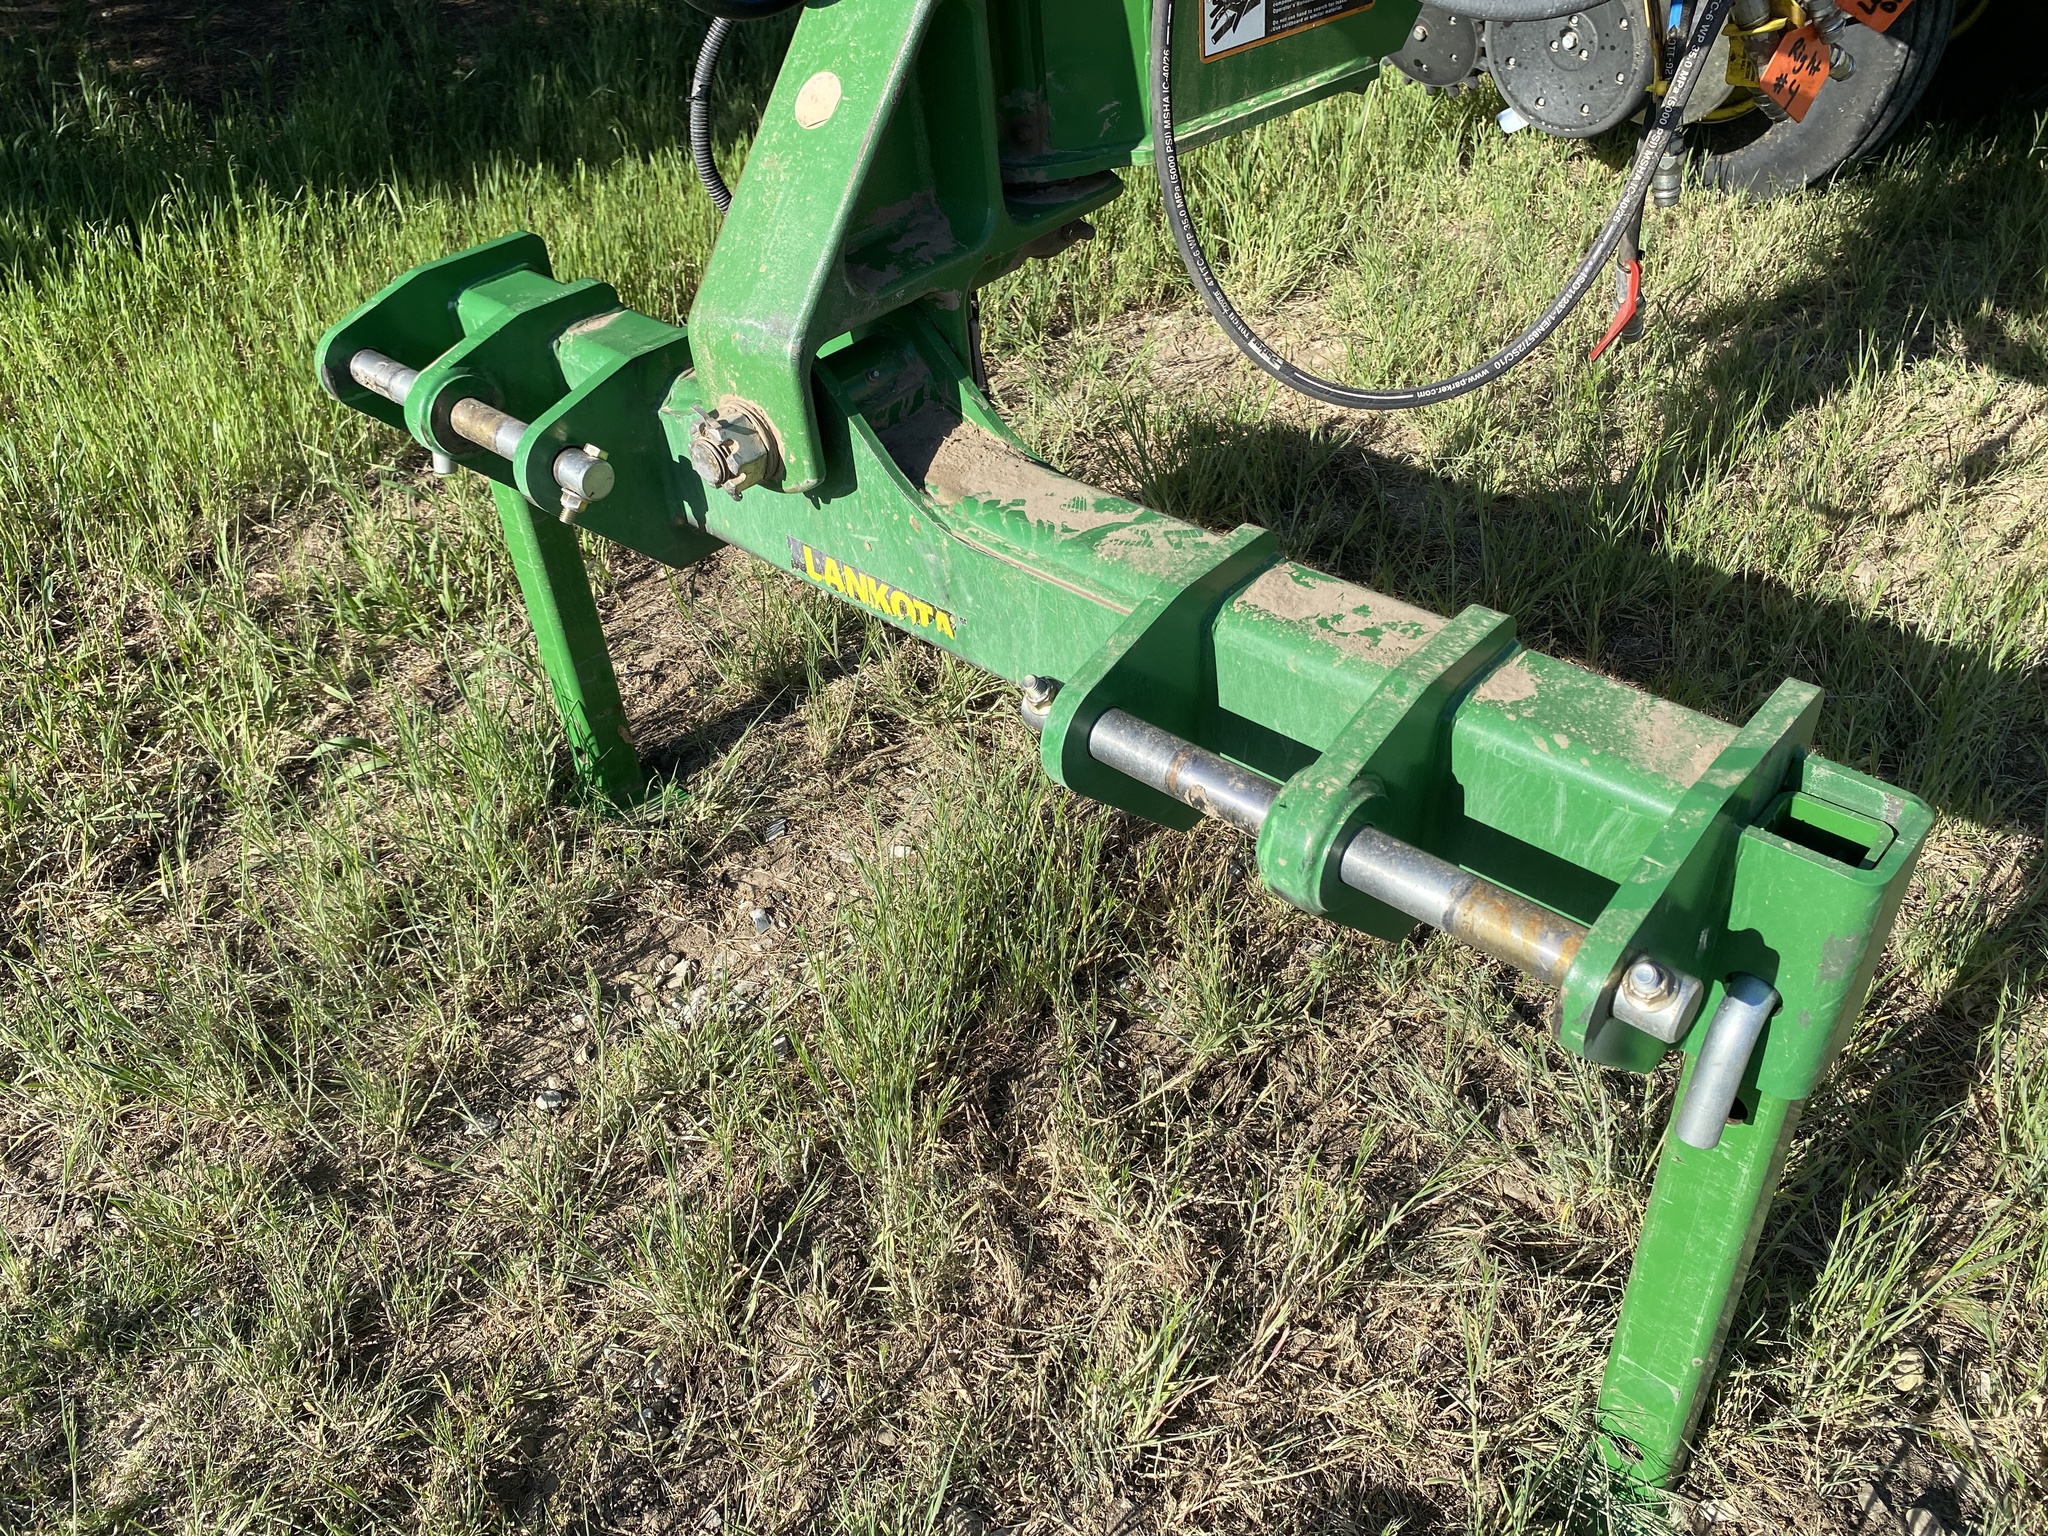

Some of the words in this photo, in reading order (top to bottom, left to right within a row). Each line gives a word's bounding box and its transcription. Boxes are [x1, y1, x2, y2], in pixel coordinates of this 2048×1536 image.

[1705, 0, 1722, 21] C-6
[1697, 24, 1711, 43] WP
[1684, 44, 1700, 68] 35.0
[1787, 37, 1821, 77] Right
[1162, 49, 1171, 93] IC-40/26
[1672, 70, 1690, 94] MPa
[1162, 95, 1171, 129] MSHA
[1659, 95, 1678, 125] (5000
[1164, 131, 1174, 153] PSI)
[1648, 127, 1664, 149] PSI)
[1167, 155, 1179, 184] (5000
[1633, 149, 1652, 181] MSHA
[1174, 185, 1184, 209] MPa
[1612, 183, 1637, 223] IC-40/26
[1178, 209, 1191, 231] 35.0
[1185, 232, 1198, 250] WP
[1192, 249, 1214, 287] 471TC-6
[1416, 368, 1490, 398] www.parker.com
[803, 544, 955, 640] LANKOTA
